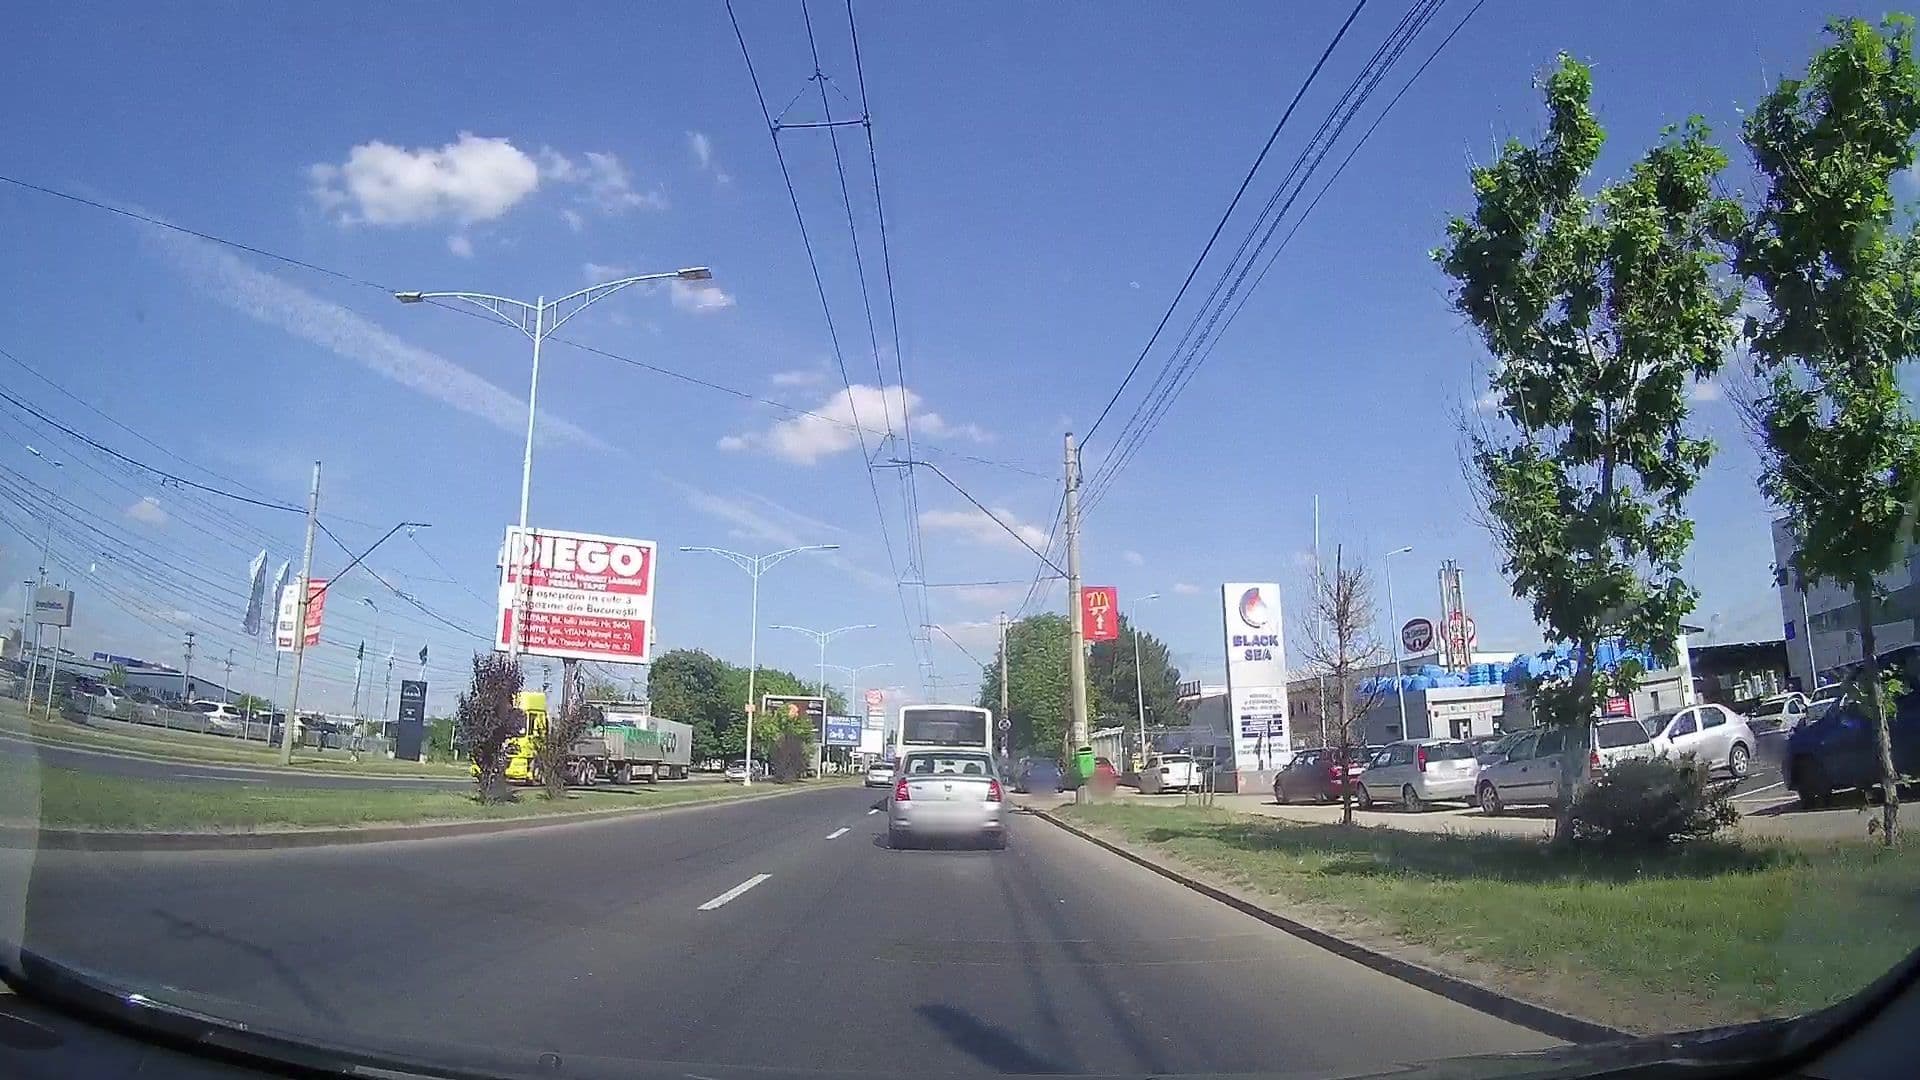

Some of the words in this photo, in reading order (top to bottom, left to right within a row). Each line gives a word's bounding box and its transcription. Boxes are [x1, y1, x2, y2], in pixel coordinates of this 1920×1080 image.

[512, 533, 644, 577] DIEGO
[566, 602, 583, 611] din
[1232, 634, 1280, 648] BLACK
[1244, 648, 1273, 662] SEA
